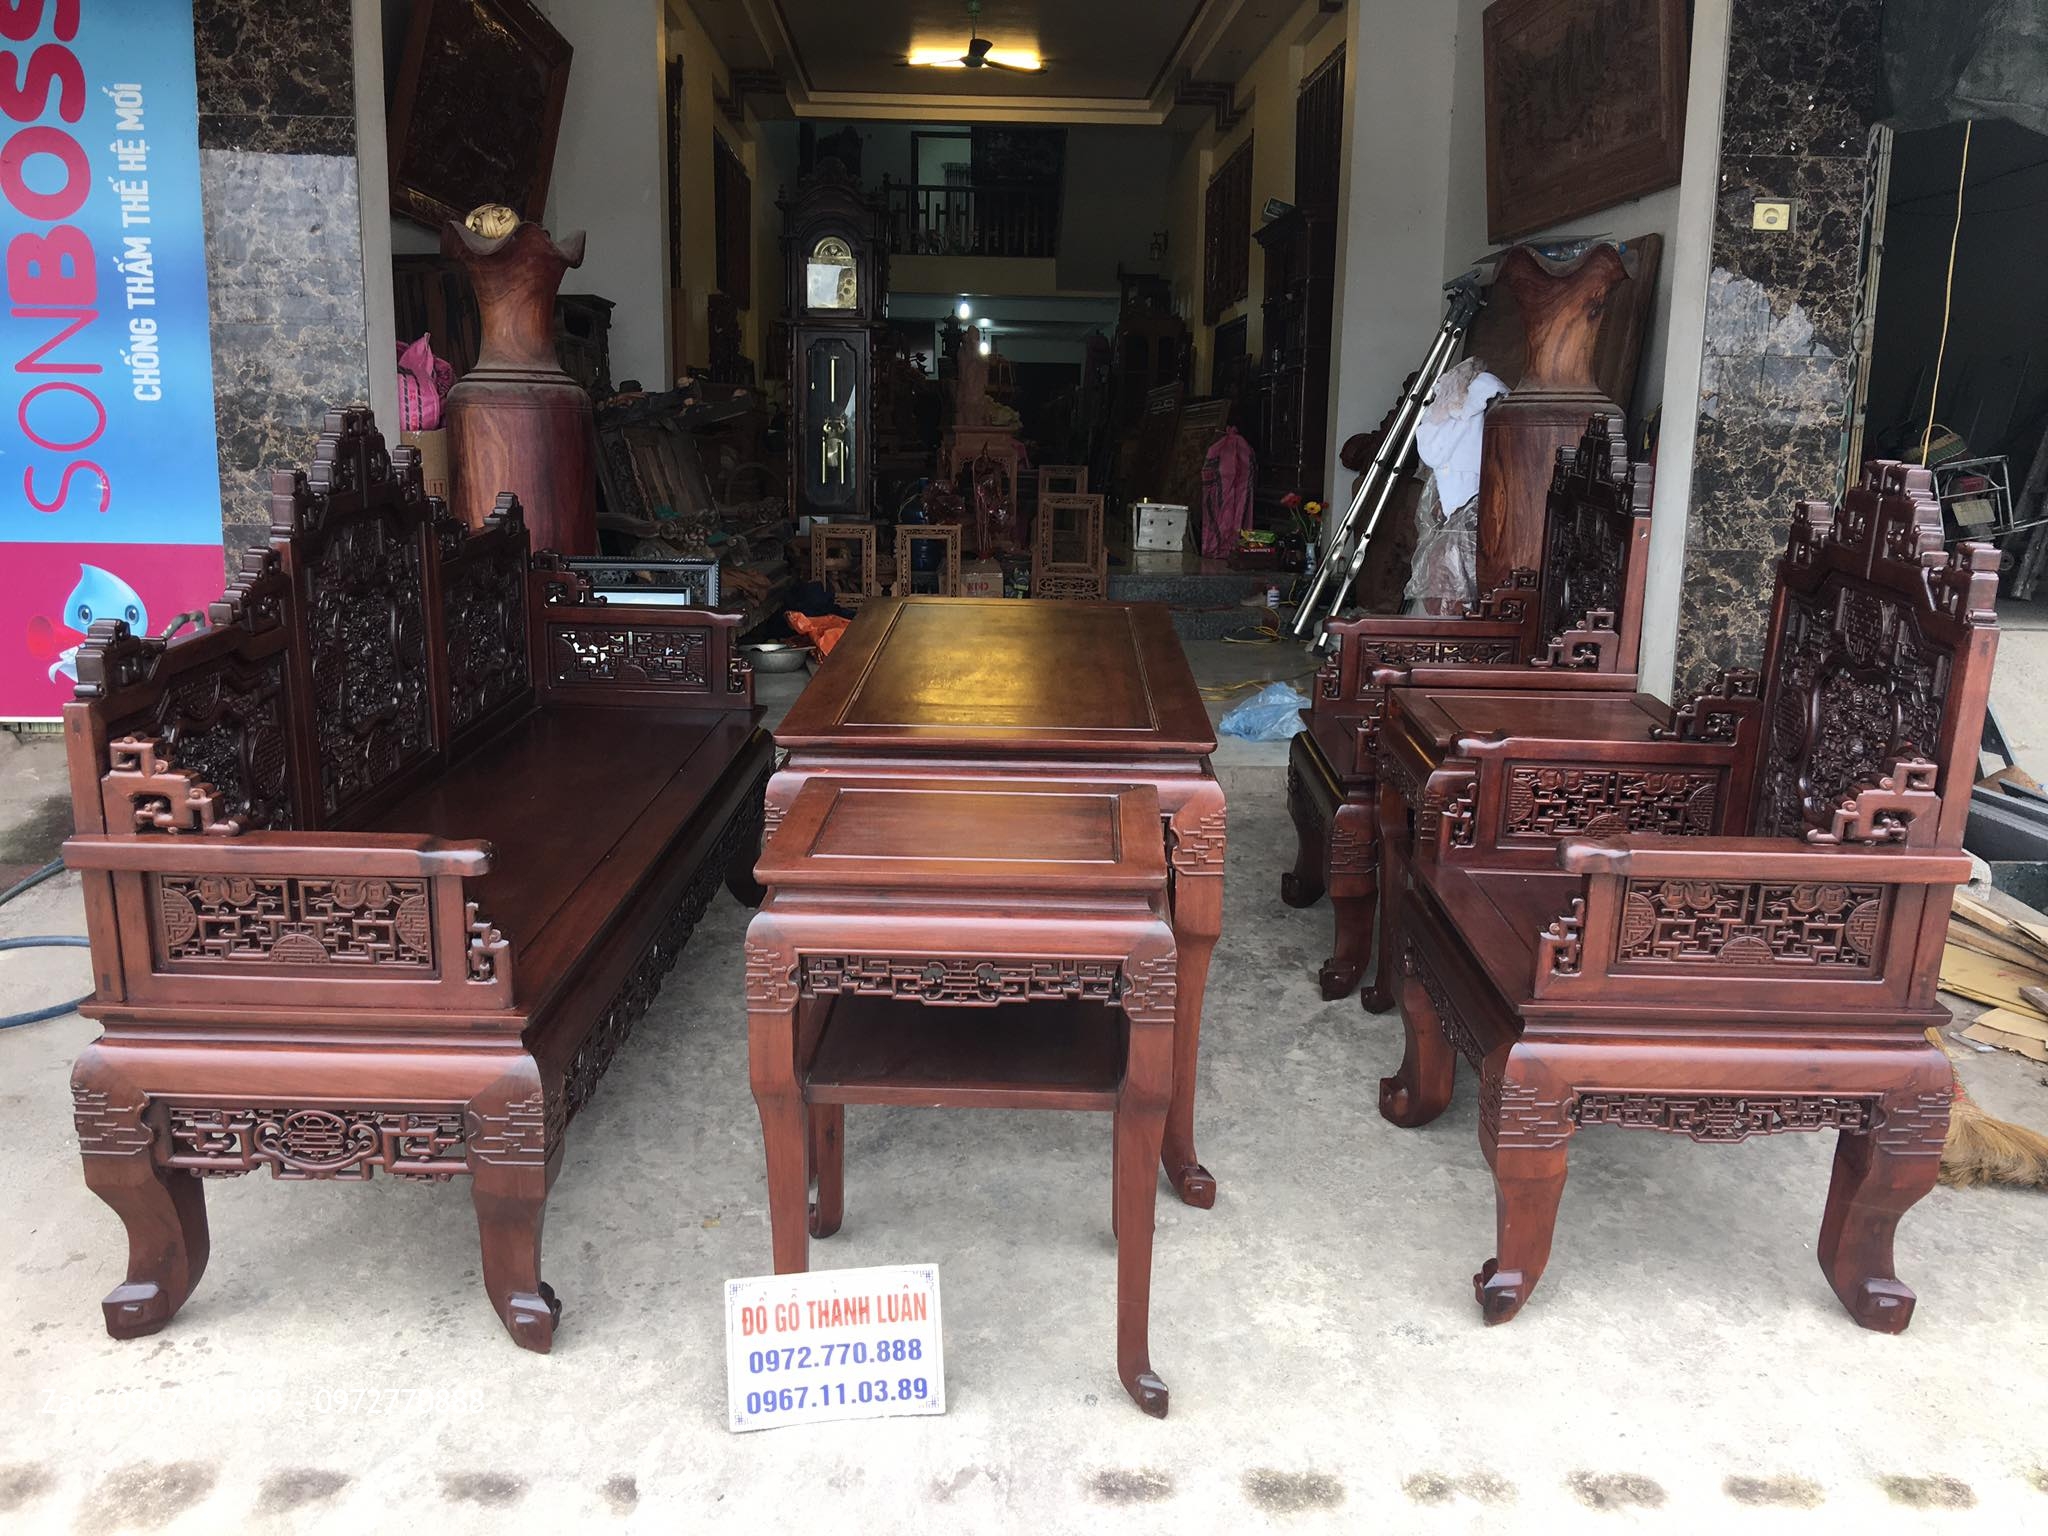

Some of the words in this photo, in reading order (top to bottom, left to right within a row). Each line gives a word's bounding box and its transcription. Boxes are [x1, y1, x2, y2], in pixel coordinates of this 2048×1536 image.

[102, 83, 145, 131] MỚI
[110, 139, 151, 171] HỆ
[108, 176, 151, 228] THẾ
[113, 237, 156, 310] THẤM
[120, 317, 162, 401] CHỐNG
[877, 1284, 927, 1323] LUÂN
[749, 1338, 923, 1374] 0972.770.888
[746, 1377, 928, 1415] 0967.11.03.89
